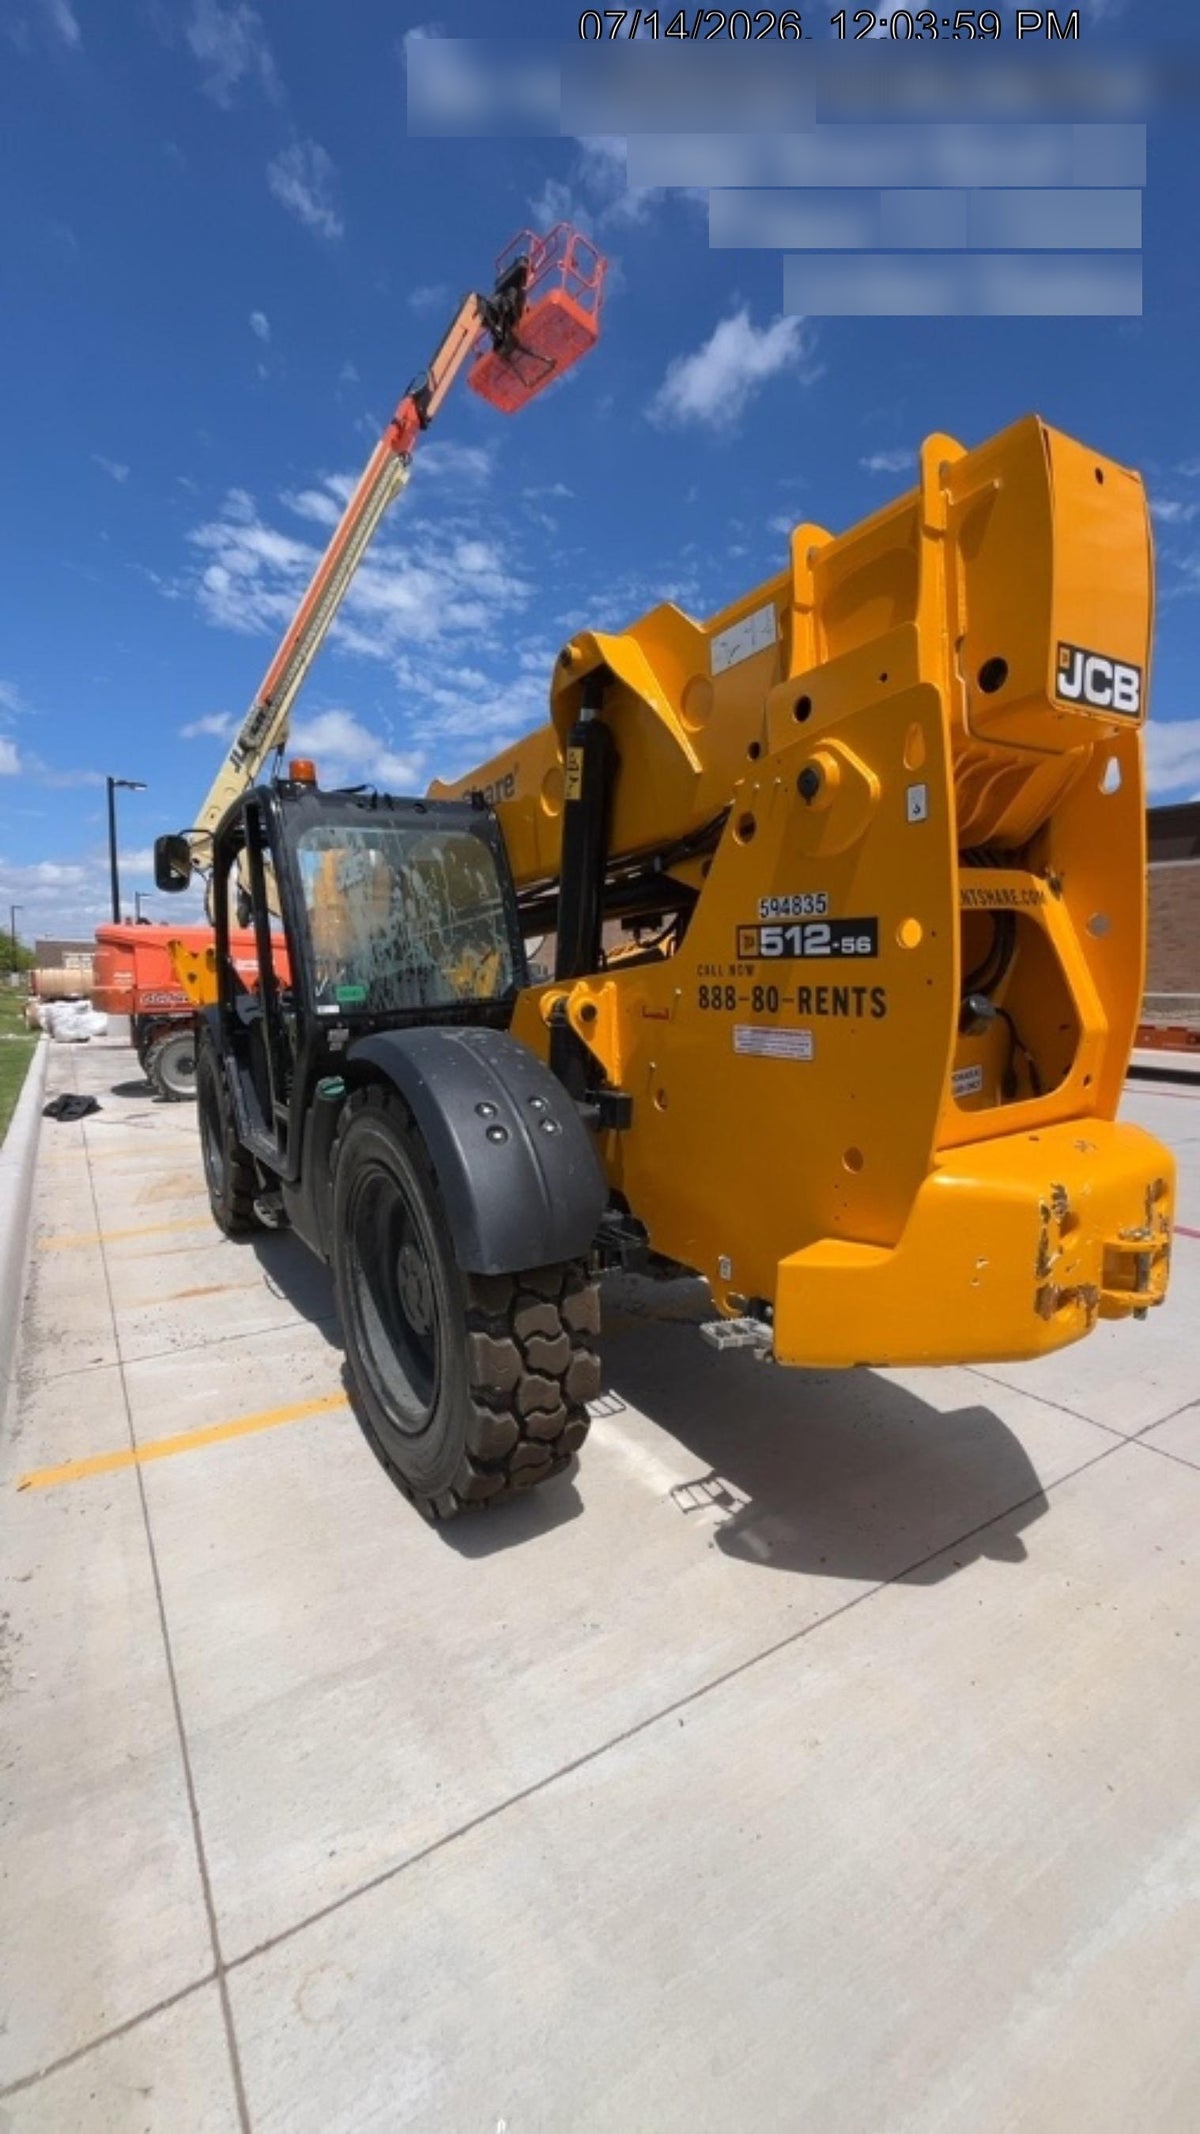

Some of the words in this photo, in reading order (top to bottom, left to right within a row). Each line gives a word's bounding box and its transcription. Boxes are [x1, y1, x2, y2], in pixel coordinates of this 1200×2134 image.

[1057, 651, 1140, 712] JCB
[760, 894, 827, 918] 594835
[697, 964, 724, 977] CALL
[728, 965, 755, 977] NOW
[698, 985, 887, 1019] 888-80-RENTS
